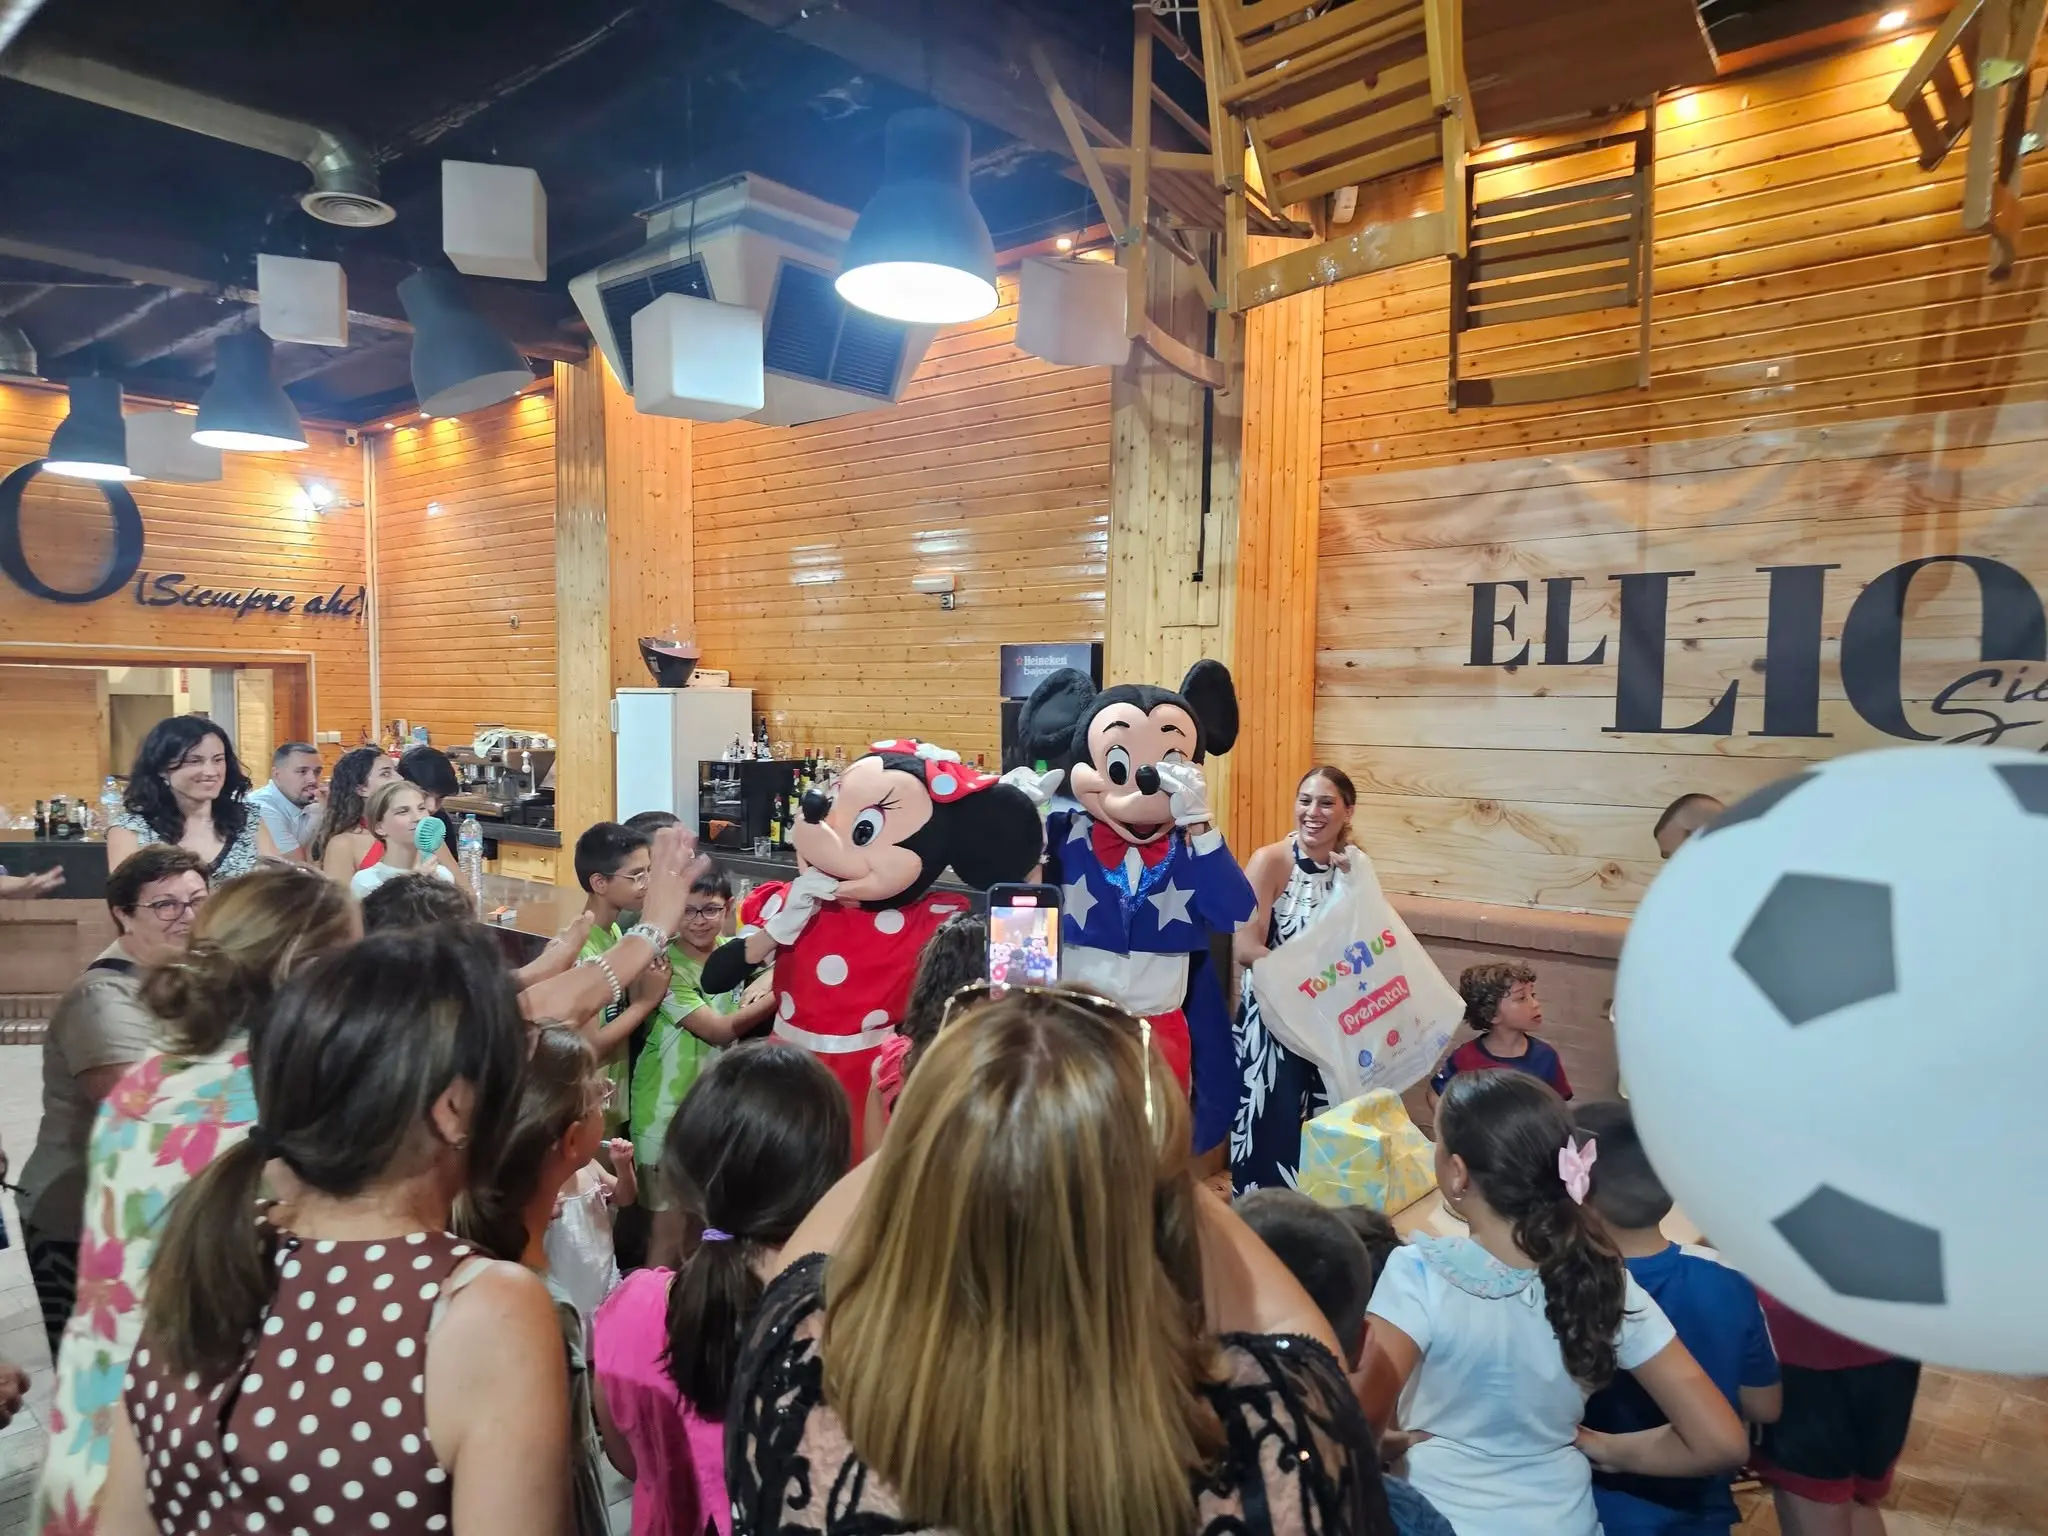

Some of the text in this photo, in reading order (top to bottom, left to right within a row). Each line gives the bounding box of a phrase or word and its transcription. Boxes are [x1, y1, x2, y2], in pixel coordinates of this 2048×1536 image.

[1023, 654, 1068, 666] Heineken
[1463, 554, 2048, 742] EL LIO
